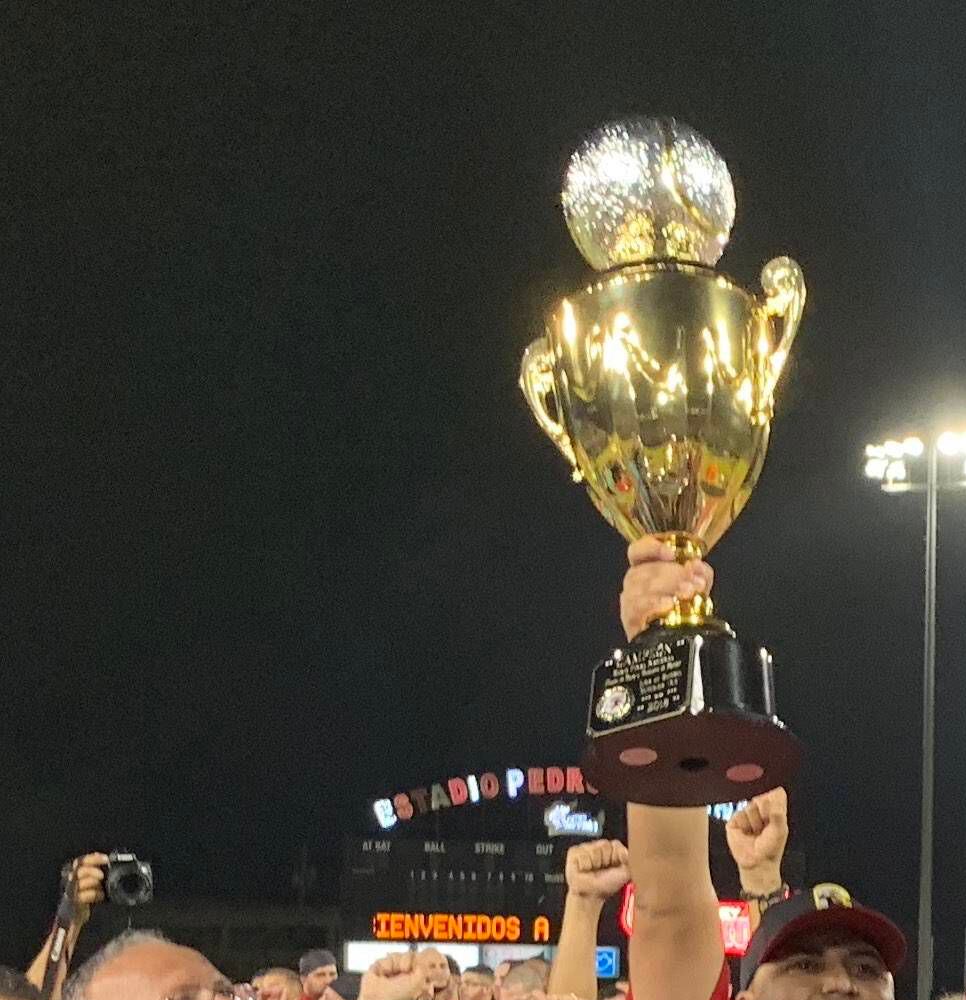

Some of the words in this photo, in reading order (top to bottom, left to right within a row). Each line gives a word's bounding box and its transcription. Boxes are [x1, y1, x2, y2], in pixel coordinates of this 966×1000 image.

[373, 772, 500, 830] ESTADIO
[506, 766, 599, 799] PEDR
[533, 915, 550, 942] A
